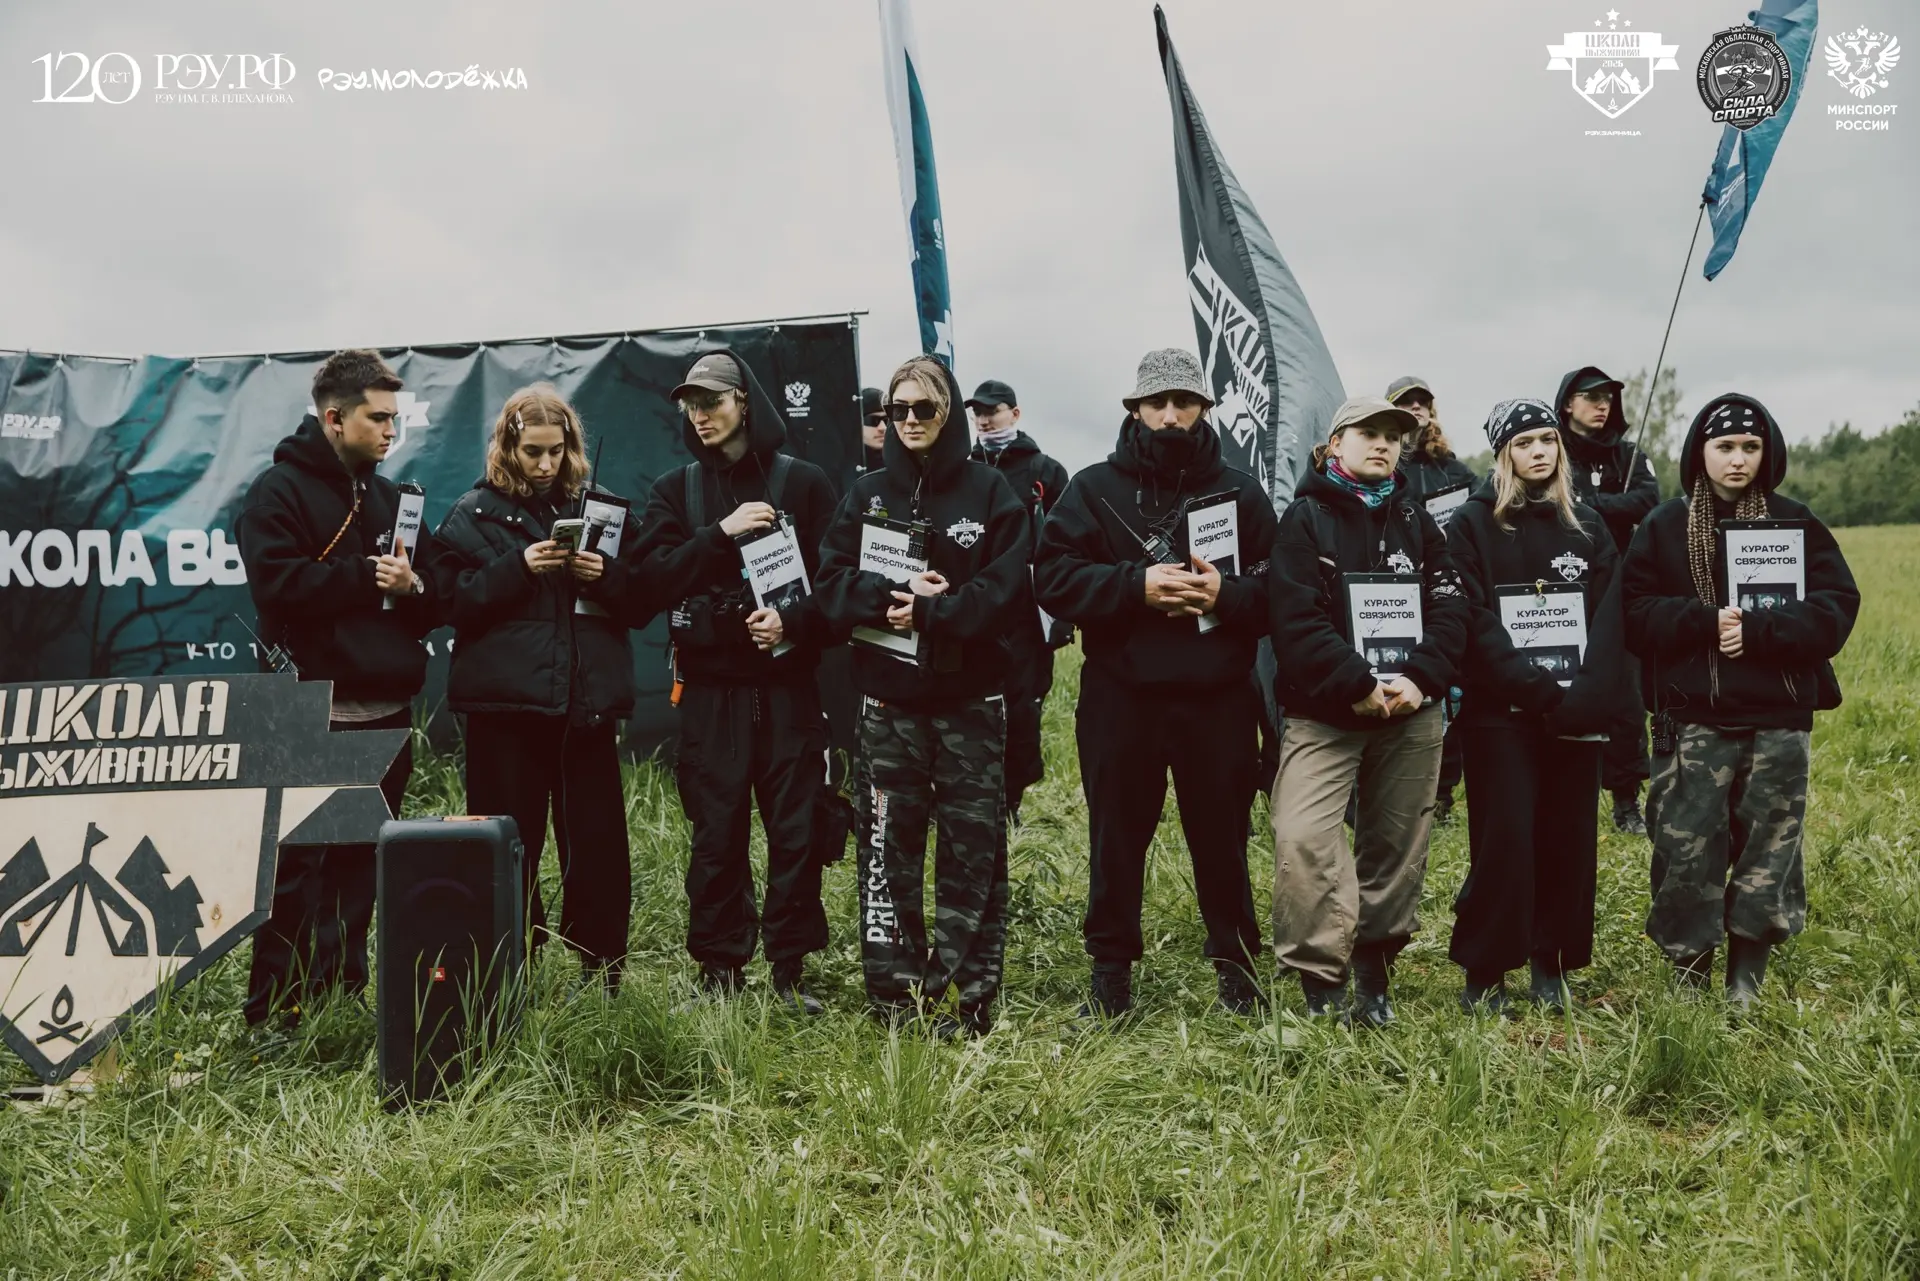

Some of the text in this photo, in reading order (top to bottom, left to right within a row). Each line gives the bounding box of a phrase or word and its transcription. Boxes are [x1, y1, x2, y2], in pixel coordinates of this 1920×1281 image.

[1198, 518, 1229, 533] КУРАТОР
[1194, 529, 1234, 547] СВЯЗИСТОВ
[1741, 545, 1790, 553] КУРАТОР
[0, 529, 157, 588] КОЛА
[756, 555, 794, 578] ДИРЕКТОР
[863, 552, 925, 573] ПРЕСС-СЛУЖБЫ
[1735, 557, 1797, 565] СВЯЗИСТОВ
[1364, 599, 1408, 607] КУРАТОР
[1359, 611, 1415, 620] СВЯЗИСТОВ
[1517, 608, 1569, 618] КУРАТОР
[1510, 619, 1578, 631] СВЯЗИСТОВ
[186, 642, 236, 660] КТО
[0, 680, 230, 746] ШКОЛА
[0, 743, 241, 790] ЫЖИВАНИЯ
